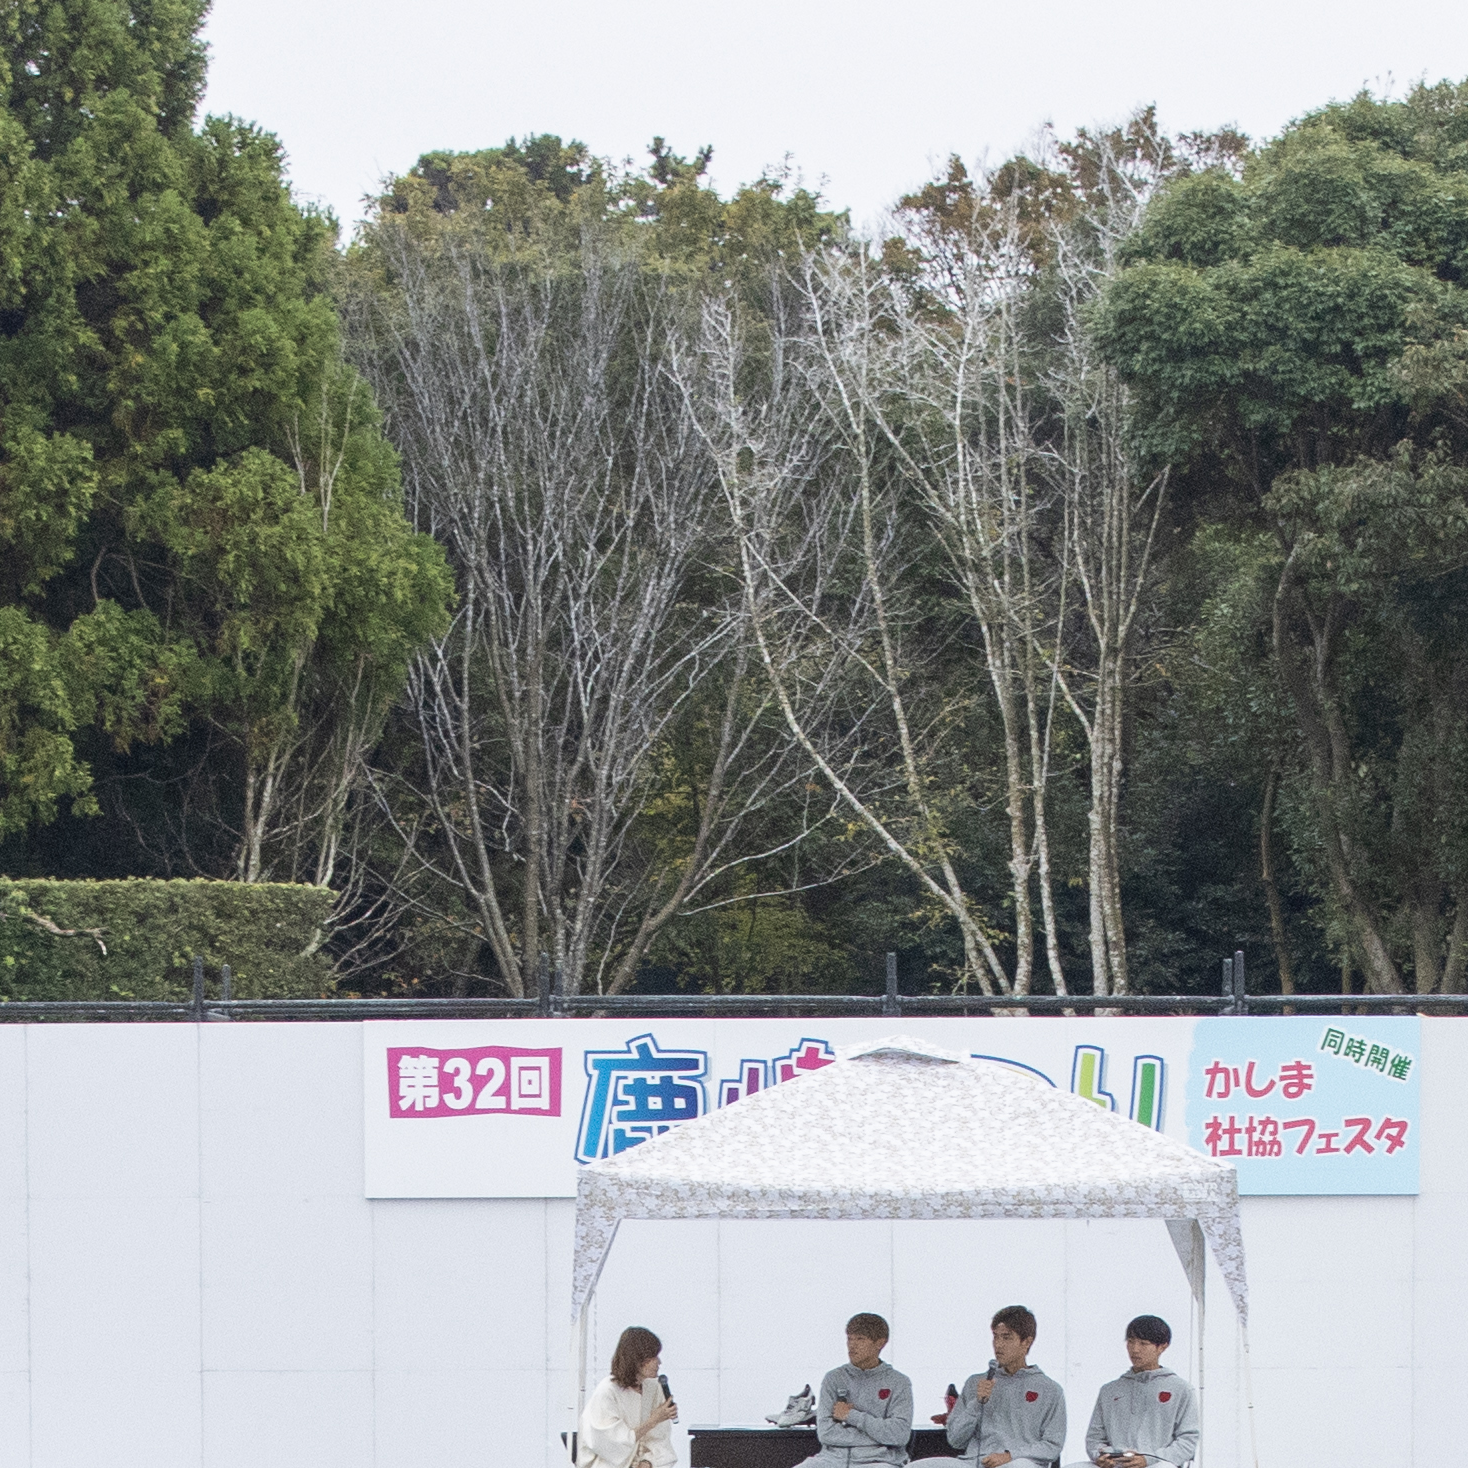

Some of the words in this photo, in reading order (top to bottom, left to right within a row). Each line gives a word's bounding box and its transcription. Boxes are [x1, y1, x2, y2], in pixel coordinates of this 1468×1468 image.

[1320, 1027, 1413, 1081] 同時開催
[396, 1054, 551, 1112] 第32回
[1204, 1060, 1314, 1099] かしま
[1203, 1115, 1409, 1158] 社協フェスタ
